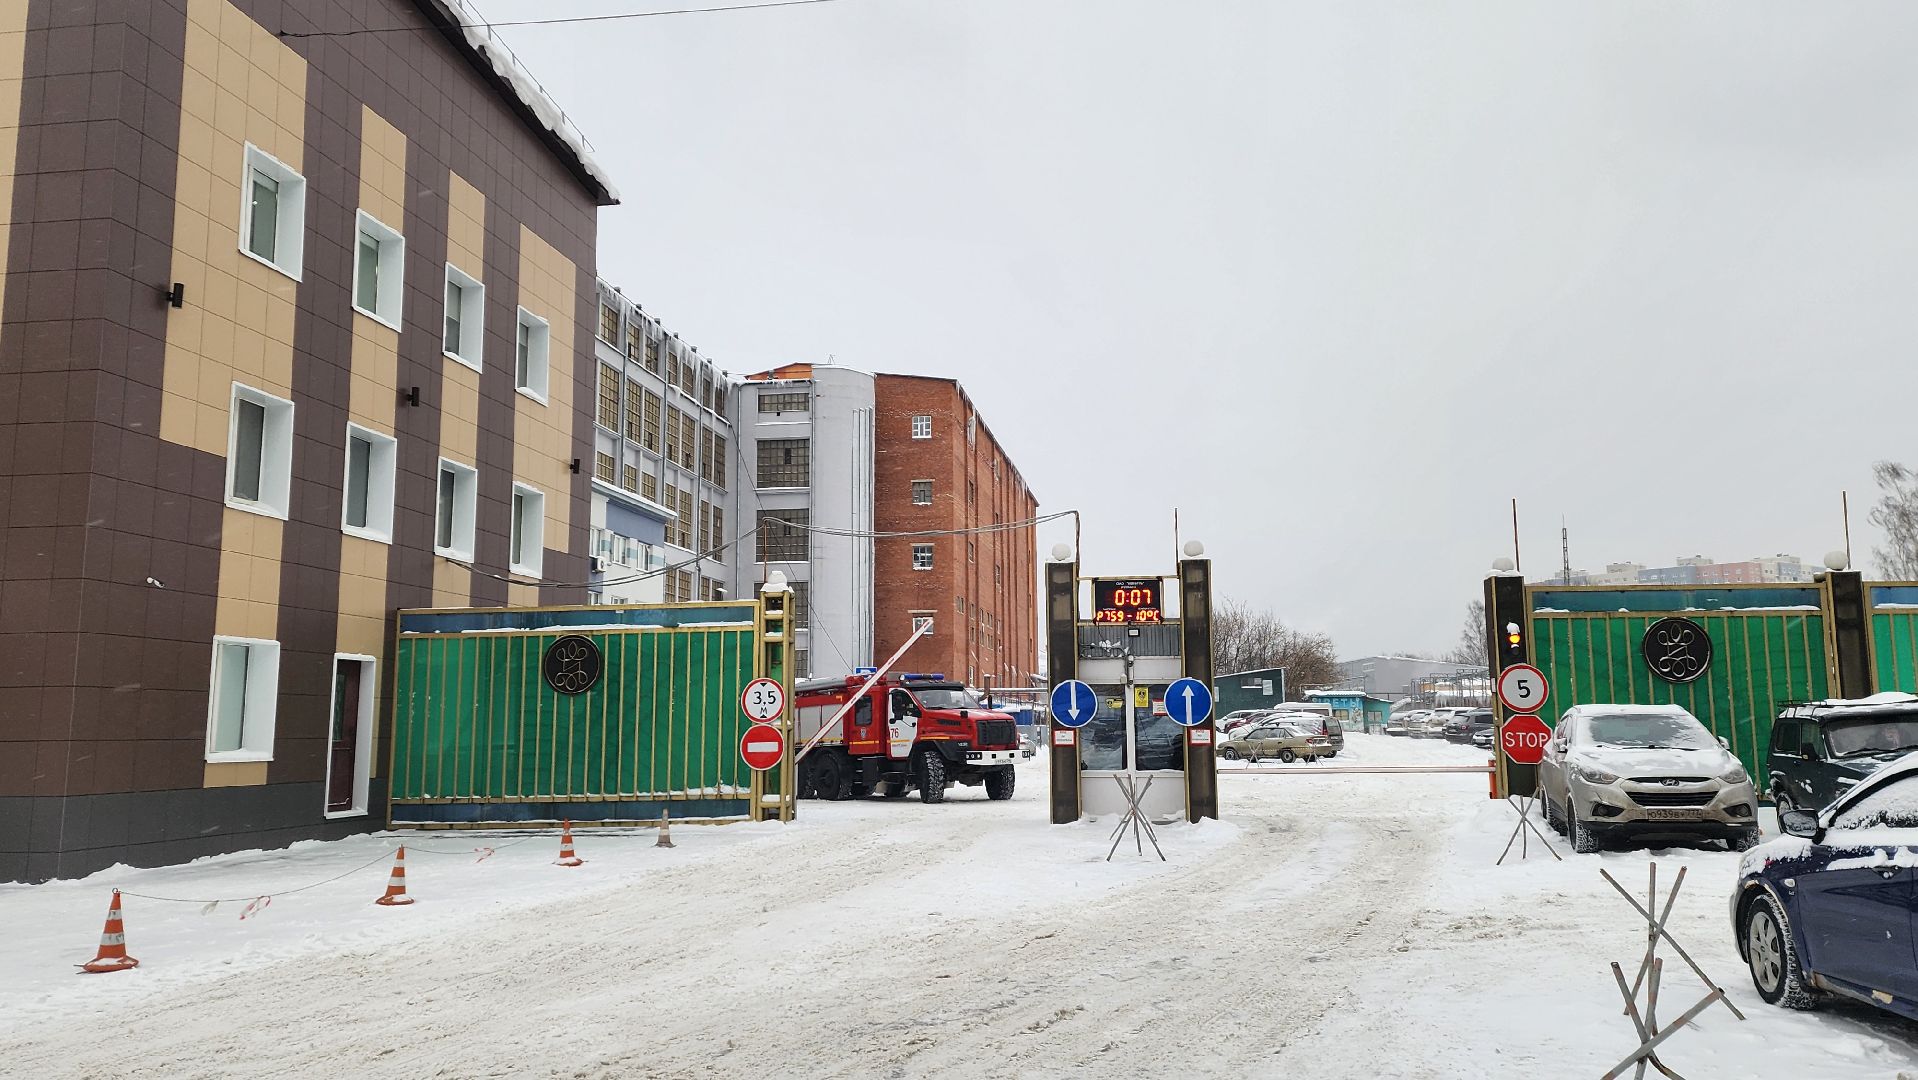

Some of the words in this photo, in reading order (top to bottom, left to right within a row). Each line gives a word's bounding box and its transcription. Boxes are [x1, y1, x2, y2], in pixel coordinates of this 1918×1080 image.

[1115, 589, 1151, 606] 0:07
[1517, 679, 1531, 699] 5
[752, 690, 777, 706] 3,5
[890, 727, 899, 739] 76
[1505, 731, 1549, 748] STOP
